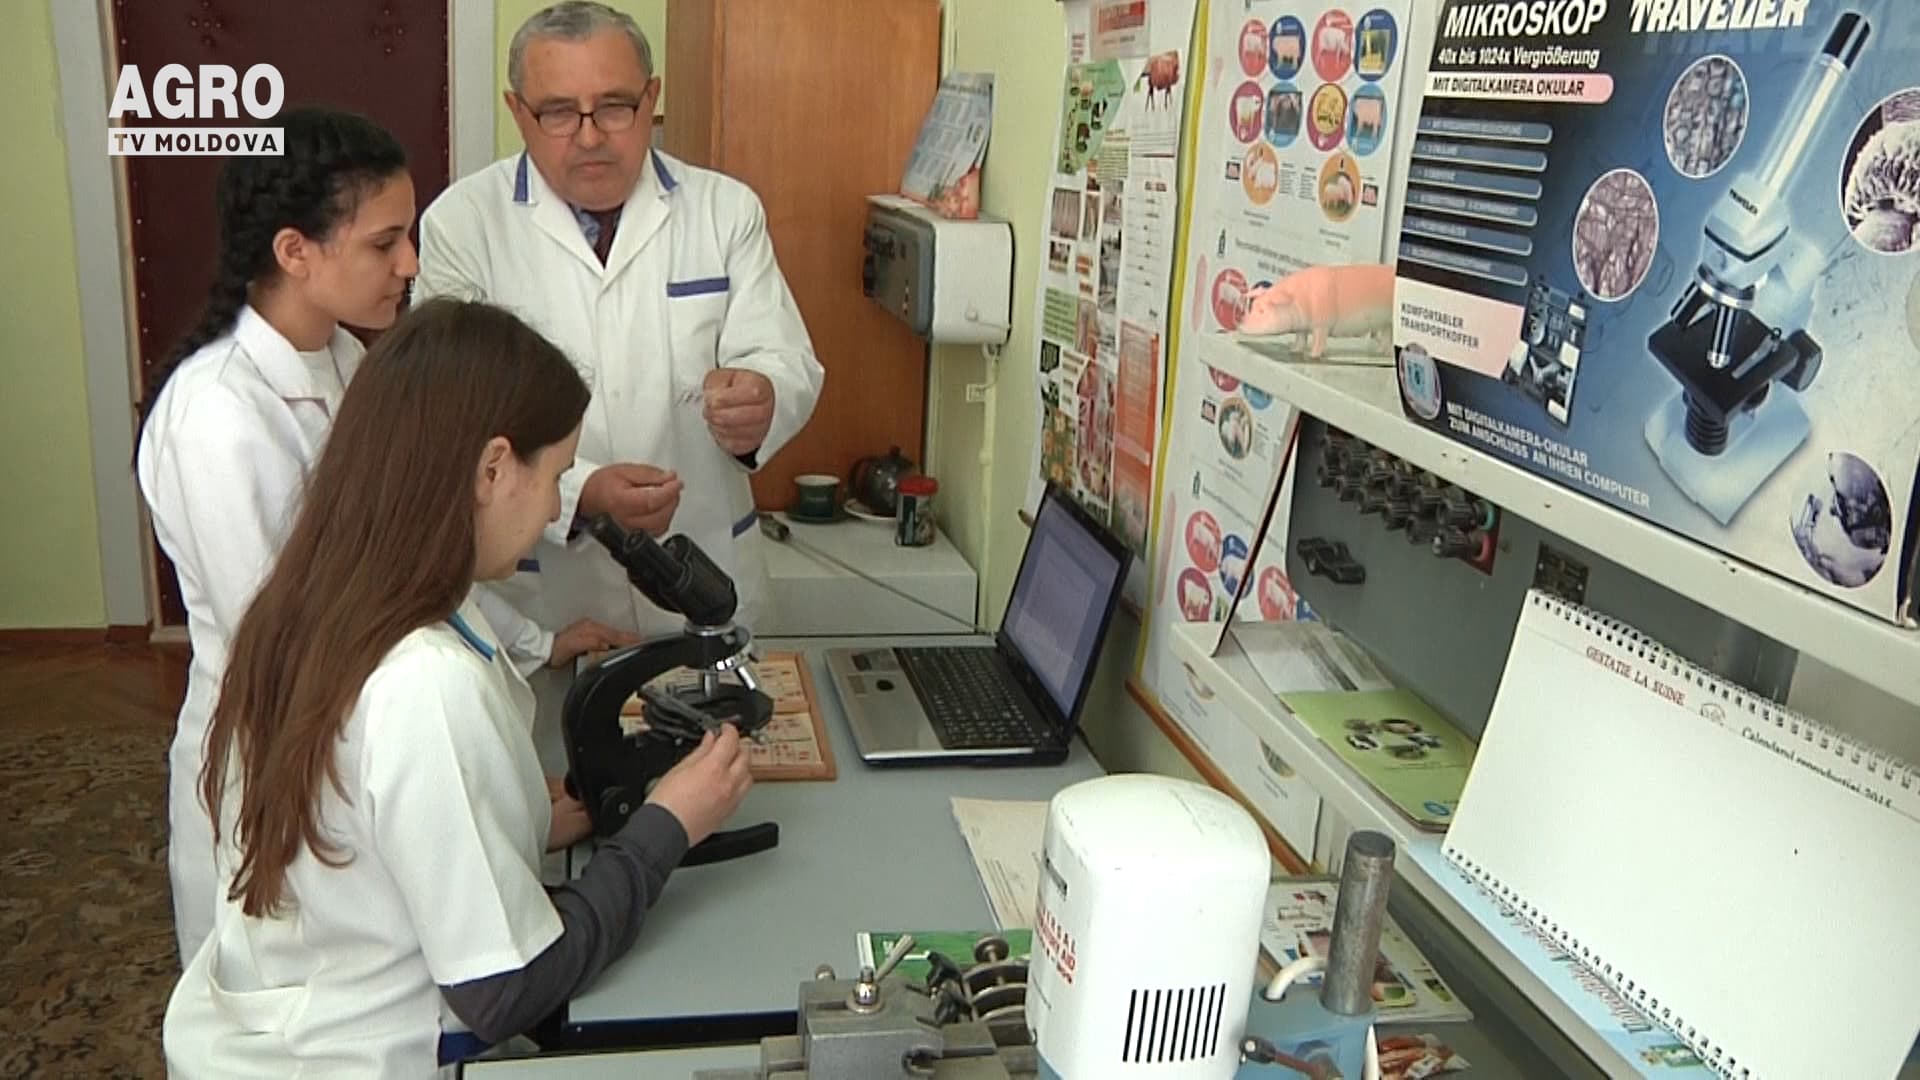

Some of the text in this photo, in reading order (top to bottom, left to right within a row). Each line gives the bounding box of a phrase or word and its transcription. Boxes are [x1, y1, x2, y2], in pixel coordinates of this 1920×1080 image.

[1443, 0, 1608, 37] MIKROSKOP
[1438, 46, 1600, 69] 40x bis 1024x Vergrößerung
[1432, 77, 1585, 96] MIT DIGITALKAMERA OKULAR
[1400, 302, 1464, 328] KOMFORTABLER
[1400, 316, 1480, 348] TRANSPORTKOFFER
[1449, 416, 1650, 506] ZUM ANSCHLUSS AN IHREN COMPUTER
[1633, 671, 1648, 688] LA
[1652, 680, 1686, 706] SUINE
